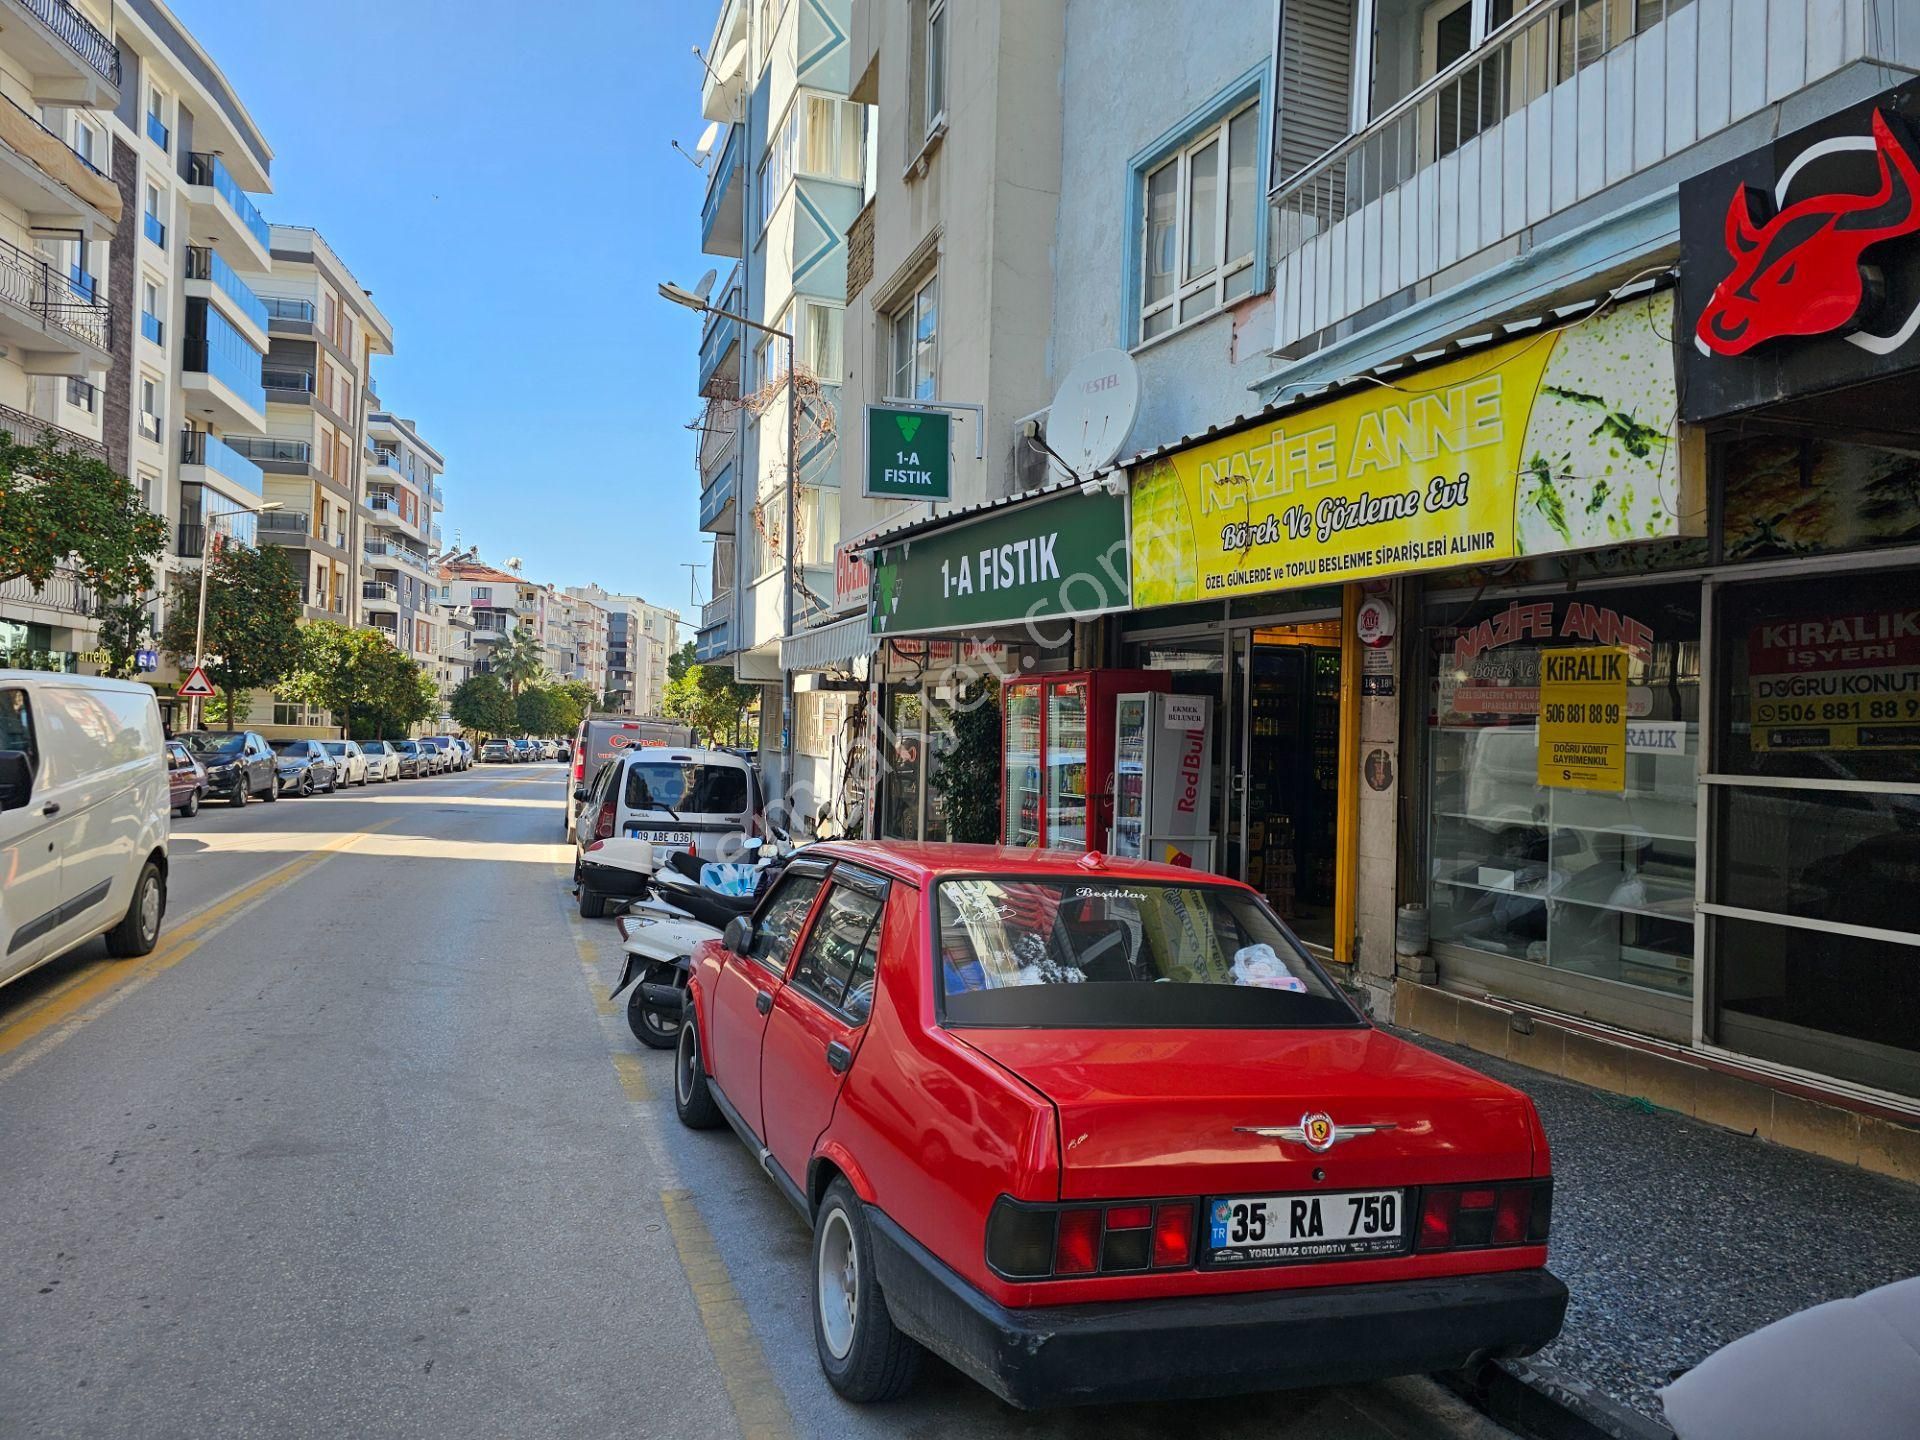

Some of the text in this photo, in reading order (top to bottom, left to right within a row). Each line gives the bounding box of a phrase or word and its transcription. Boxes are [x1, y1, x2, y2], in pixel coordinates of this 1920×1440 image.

[1200, 373, 1503, 514] NAZİFE ANNE
[896, 451, 920, 466] 1-A
[884, 468, 932, 485] FISTIK
[1221, 472, 1470, 550] Börek Ve Gözleme Evi
[941, 532, 1061, 598] 1-A FISTIK
[1205, 531, 1495, 590] ÖZEL GÜNLERDE ve TOPLU BESLENME SİPARİŞLERİ ALINIR
[1454, 601, 1654, 673] NAZİFE ANNE
[1473, 657, 1514, 680] Börek
[1759, 672, 1920, 699] DOĞRU KONUT
[1172, 705, 1198, 713] EKMEK
[1546, 703, 1565, 724] 506
[1567, 703, 1586, 724] 881
[1589, 703, 1603, 724] 88
[1605, 703, 1620, 724] 99
[1778, 703, 1816, 722] 506
[1822, 701, 1861, 720] 881
[1870, 700, 1898, 718] 88
[1553, 742, 1609, 755] DOĞRU KONUT
[1553, 754, 1609, 767] GAYRİMENKUL
[638, 831, 689, 842] 09 ABE 036
[1232, 1194, 1395, 1243] 35 RA 750
[1213, 1228, 1225, 1239] TR
[1249, 1246, 1299, 1259] YORULMAZ
